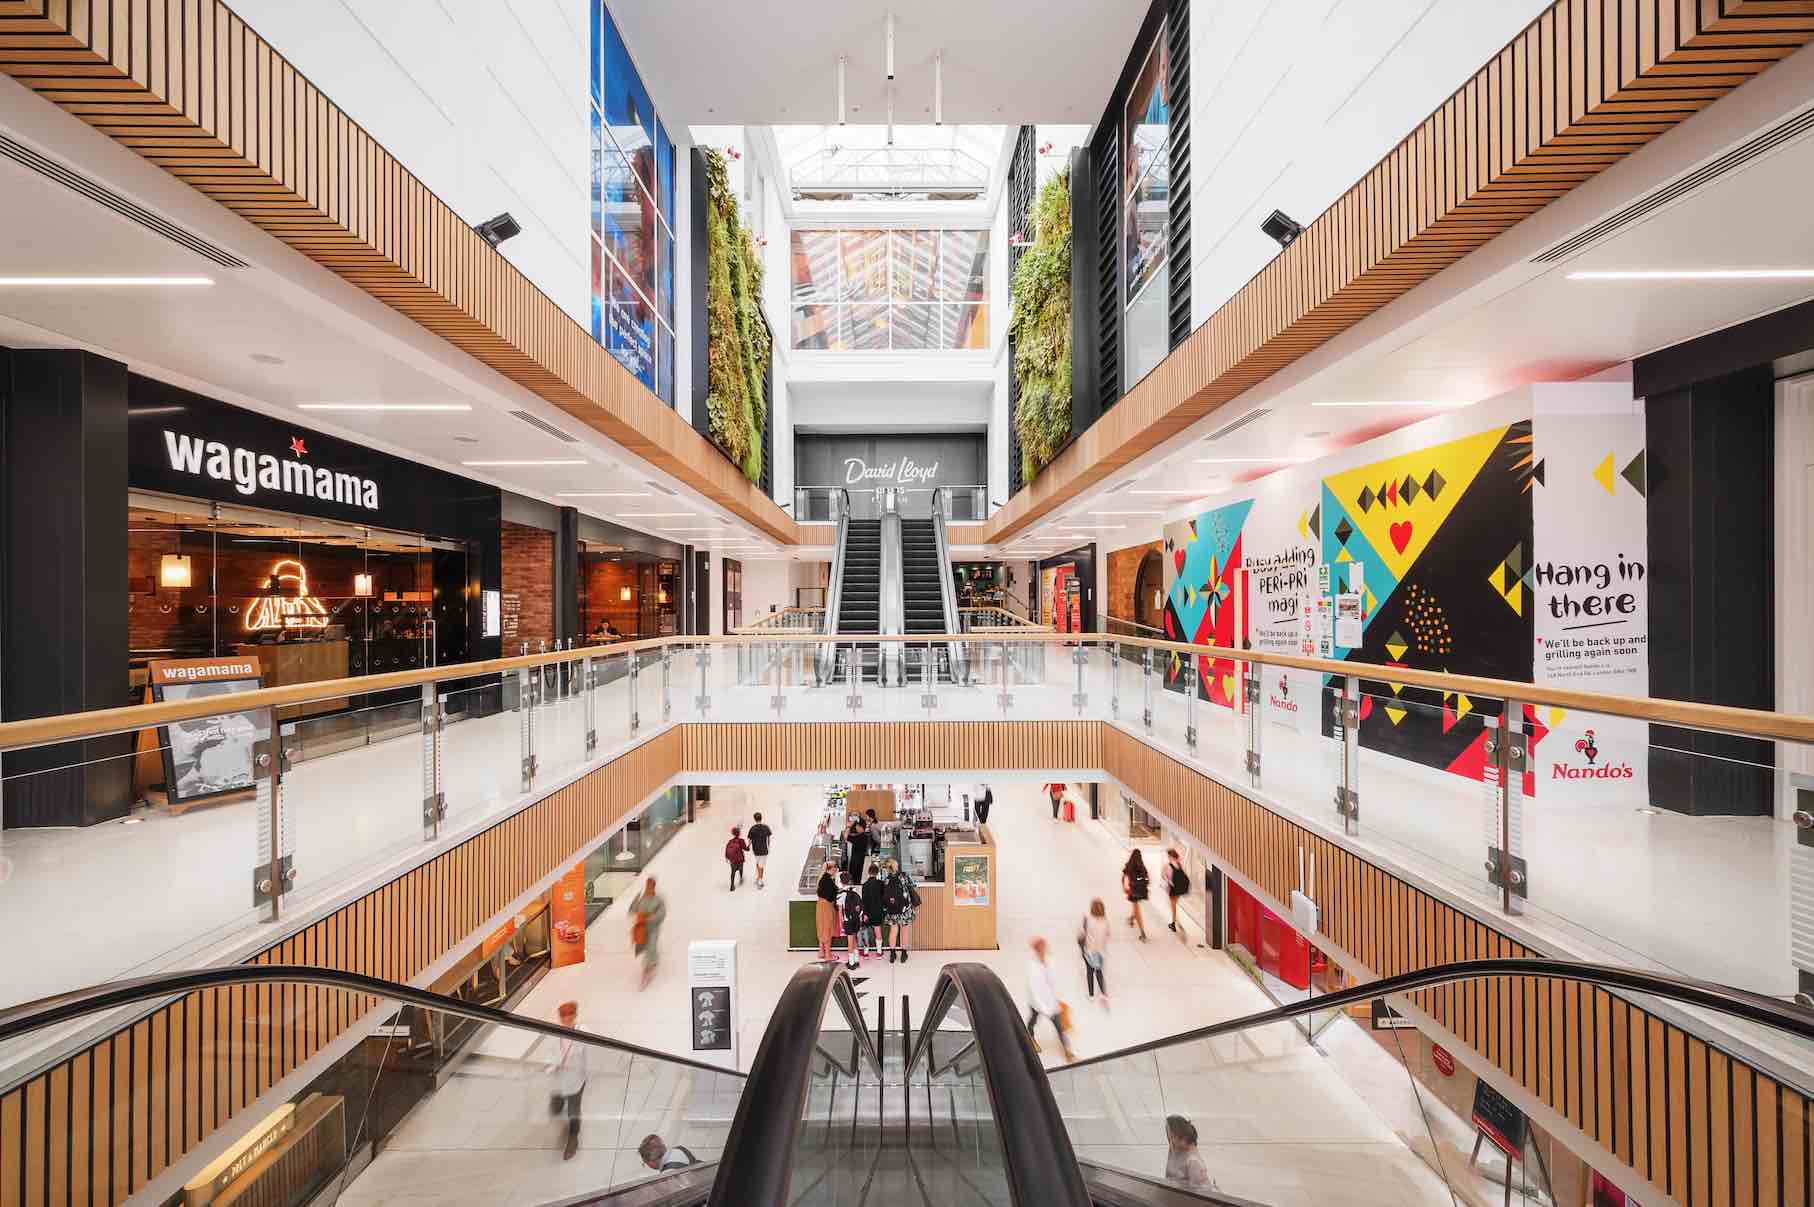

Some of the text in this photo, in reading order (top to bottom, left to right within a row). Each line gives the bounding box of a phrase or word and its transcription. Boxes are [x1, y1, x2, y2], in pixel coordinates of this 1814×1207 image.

[164, 430, 378, 510] wagamama
[844, 456, 938, 484] David Lloyd
[1536, 553, 1645, 590] Hang in
[1548, 593, 1636, 618] there
[1545, 634, 1647, 649] We'll be back up and
[1545, 646, 1638, 661] grilling again soon
[162, 663, 253, 680] wagamama
[1551, 761, 1633, 779] Nando's
